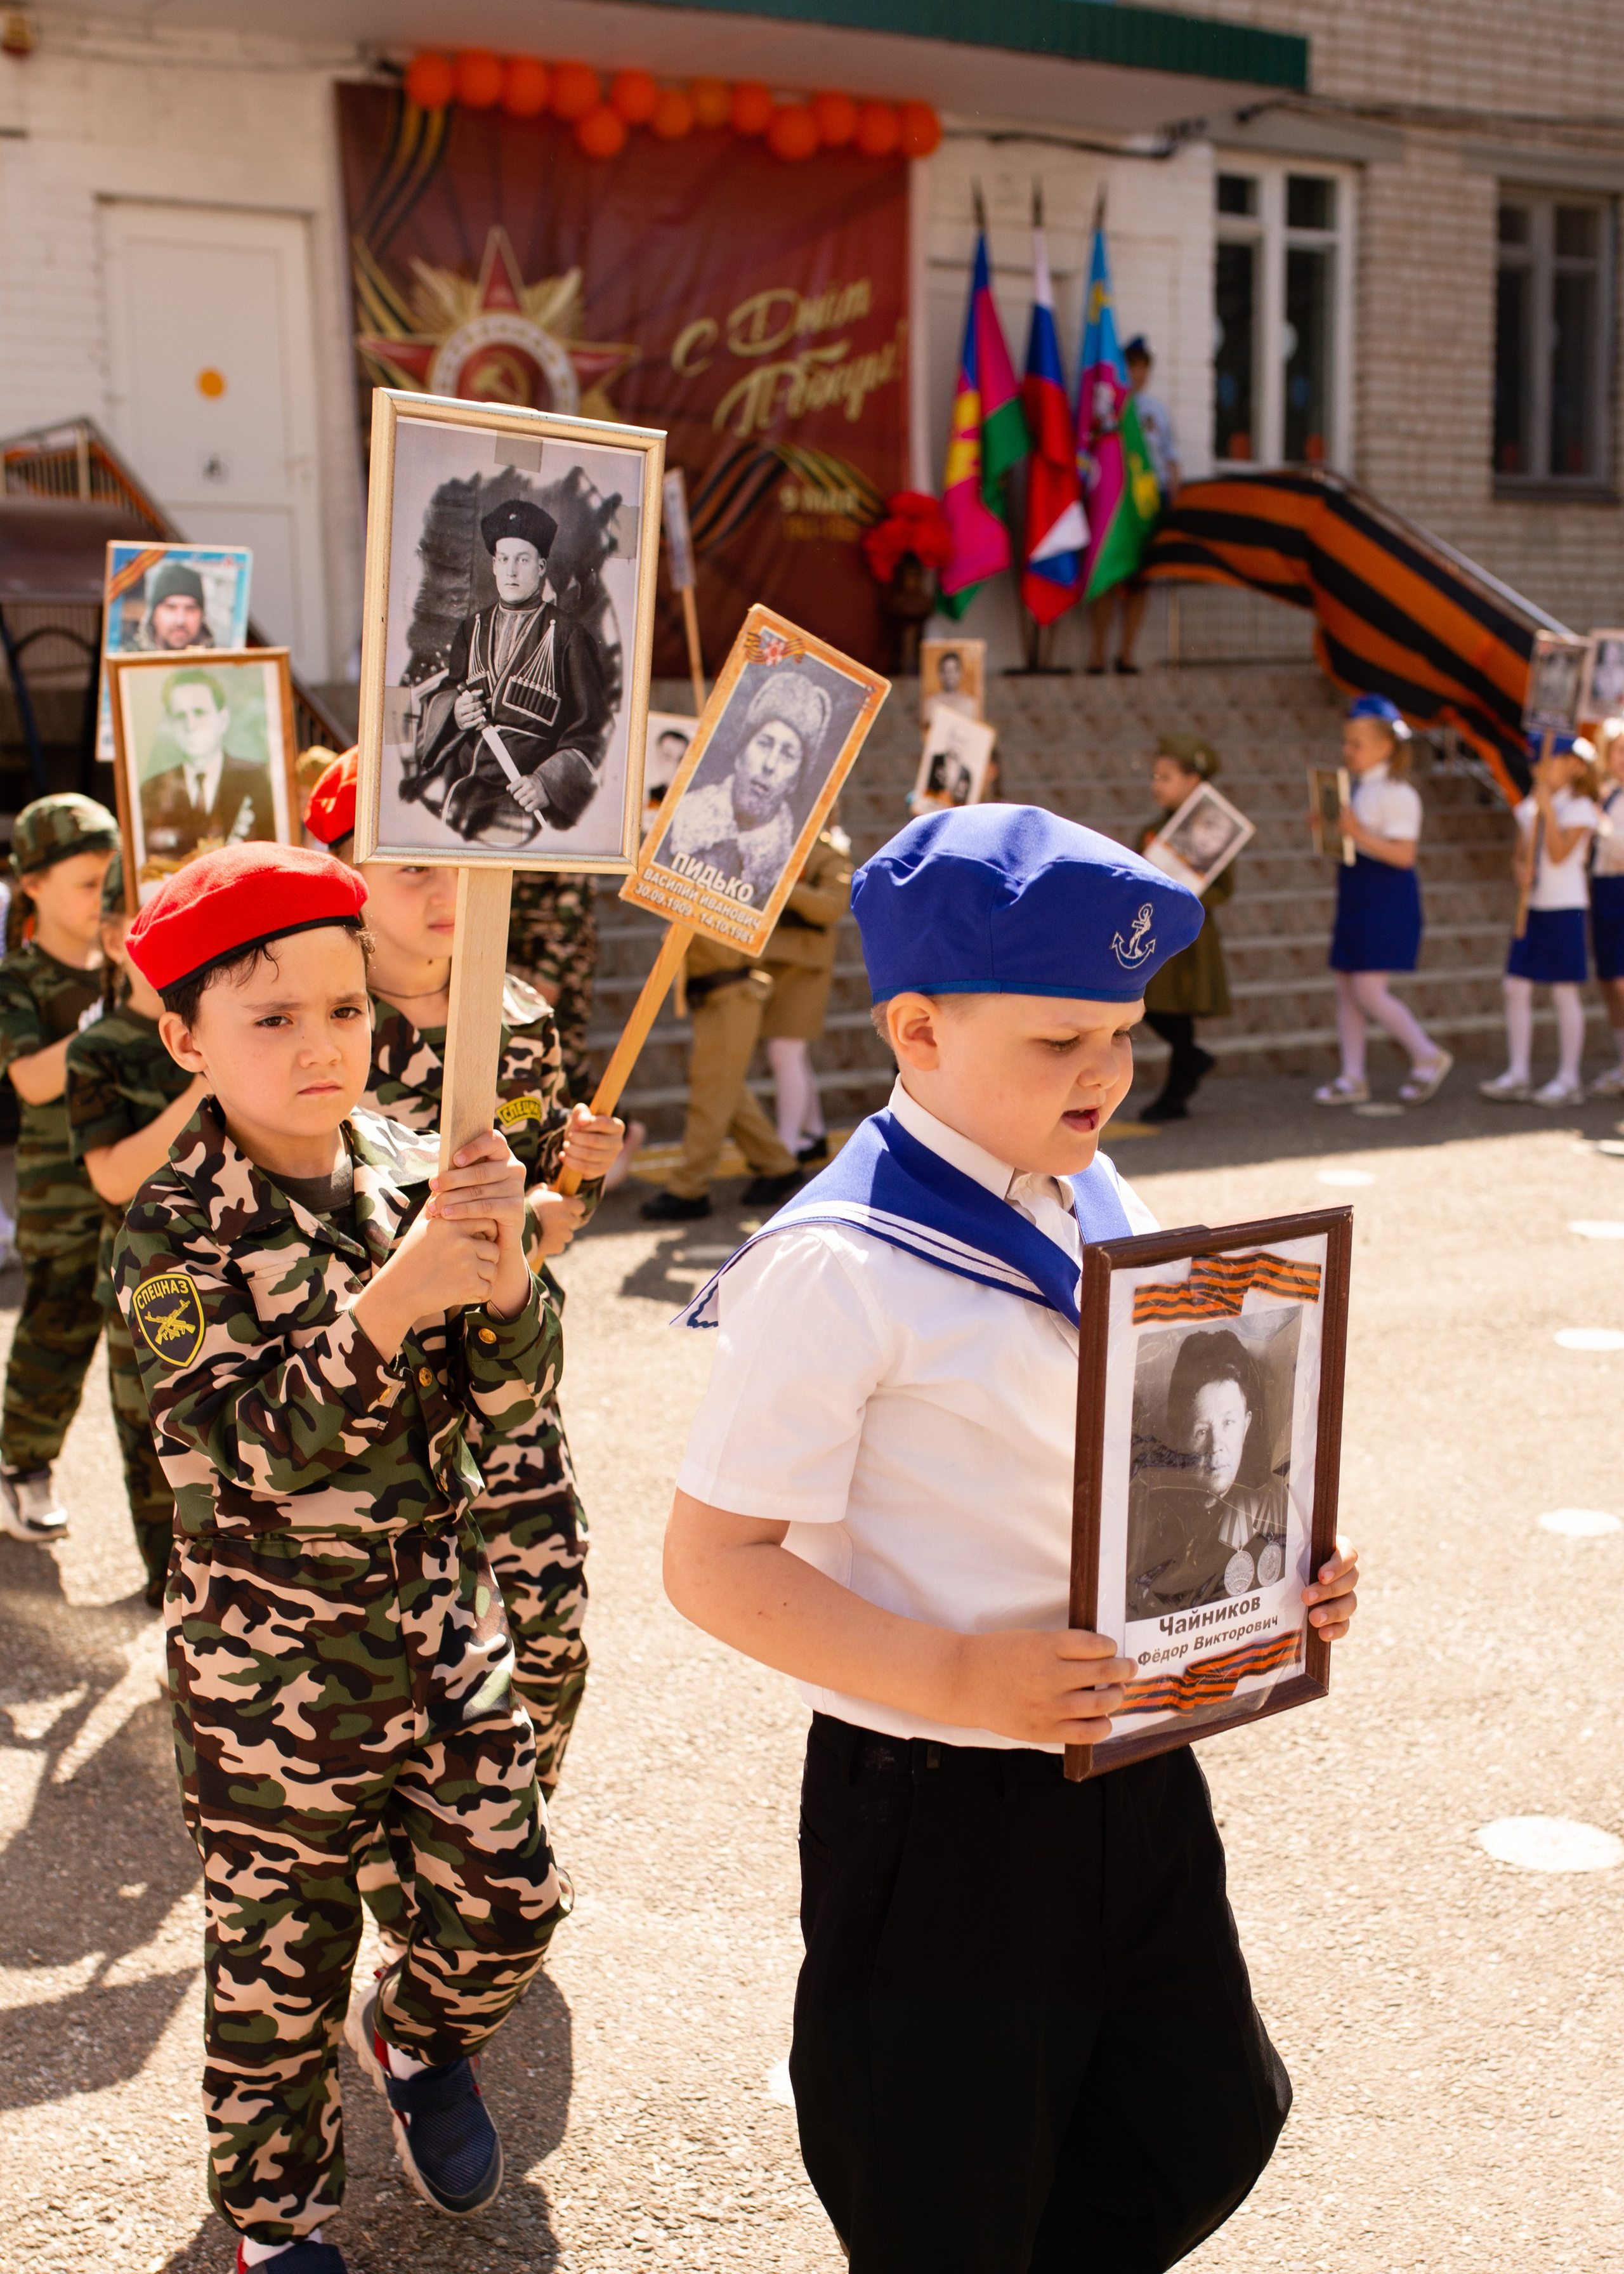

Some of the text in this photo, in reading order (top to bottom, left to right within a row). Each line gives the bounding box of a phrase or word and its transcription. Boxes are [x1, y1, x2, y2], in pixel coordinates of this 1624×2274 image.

[671, 317, 719, 378] С
[671, 851, 754, 902] ПИДЬКО
[634, 882, 693, 917] 30.09.1909
[698, 893, 761, 930] ИВАНОВИЧ
[136, 1279, 189, 1310] СПЕЦНАЗ
[1160, 1596, 1261, 1636] Чайников
[1137, 1615, 1278, 1666] Фёдор Викторович
